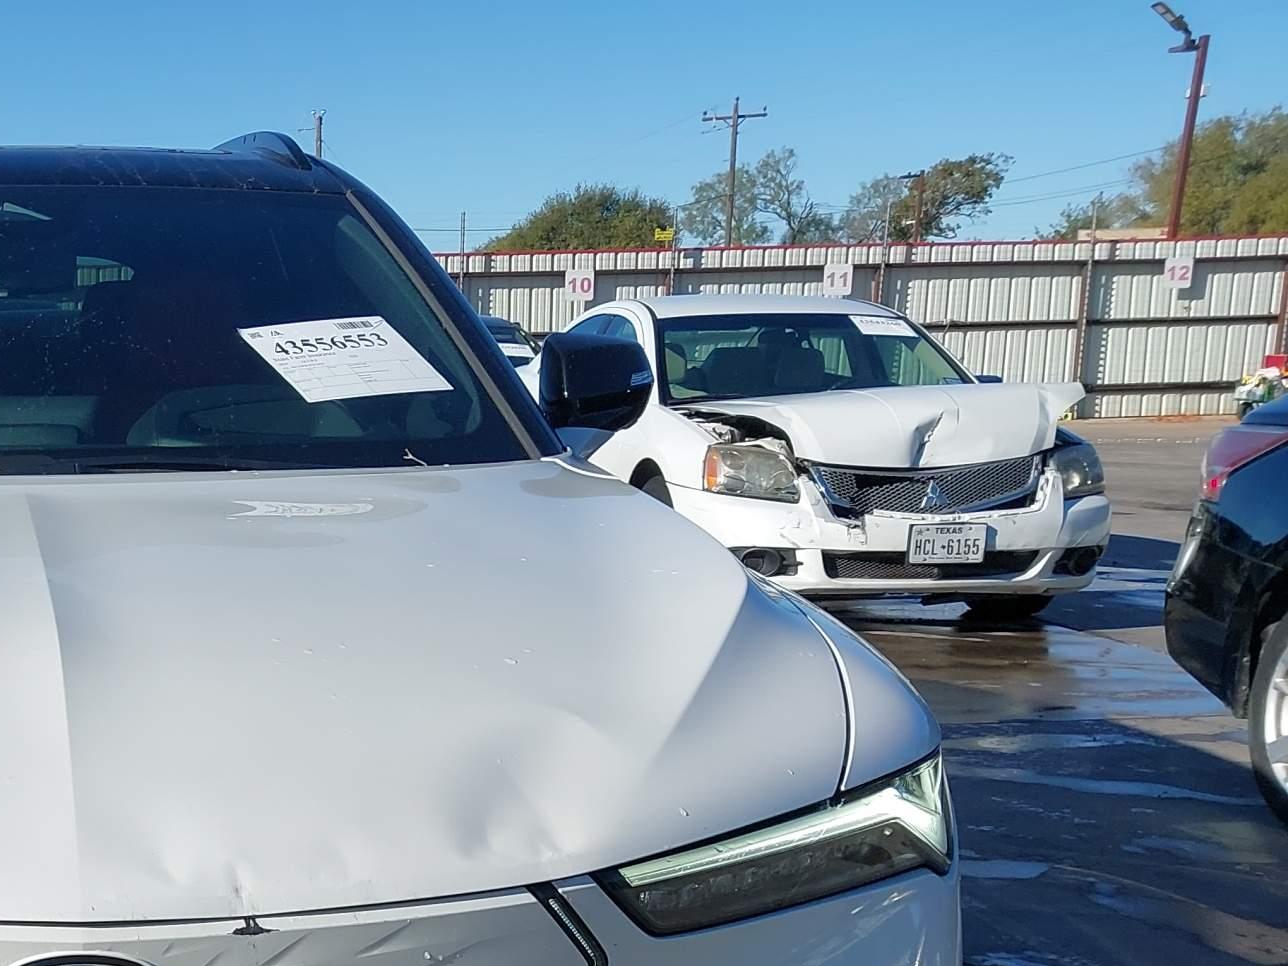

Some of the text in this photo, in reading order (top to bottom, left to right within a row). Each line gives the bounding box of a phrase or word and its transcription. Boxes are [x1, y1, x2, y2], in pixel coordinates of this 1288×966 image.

[826, 271, 848, 288] 11
[1167, 265, 1190, 281] 12
[568, 277, 592, 293] 10
[274, 333, 388, 355] 43556553
[935, 527, 963, 535] TEXAS
[914, 538, 980, 556] HCL 6155
